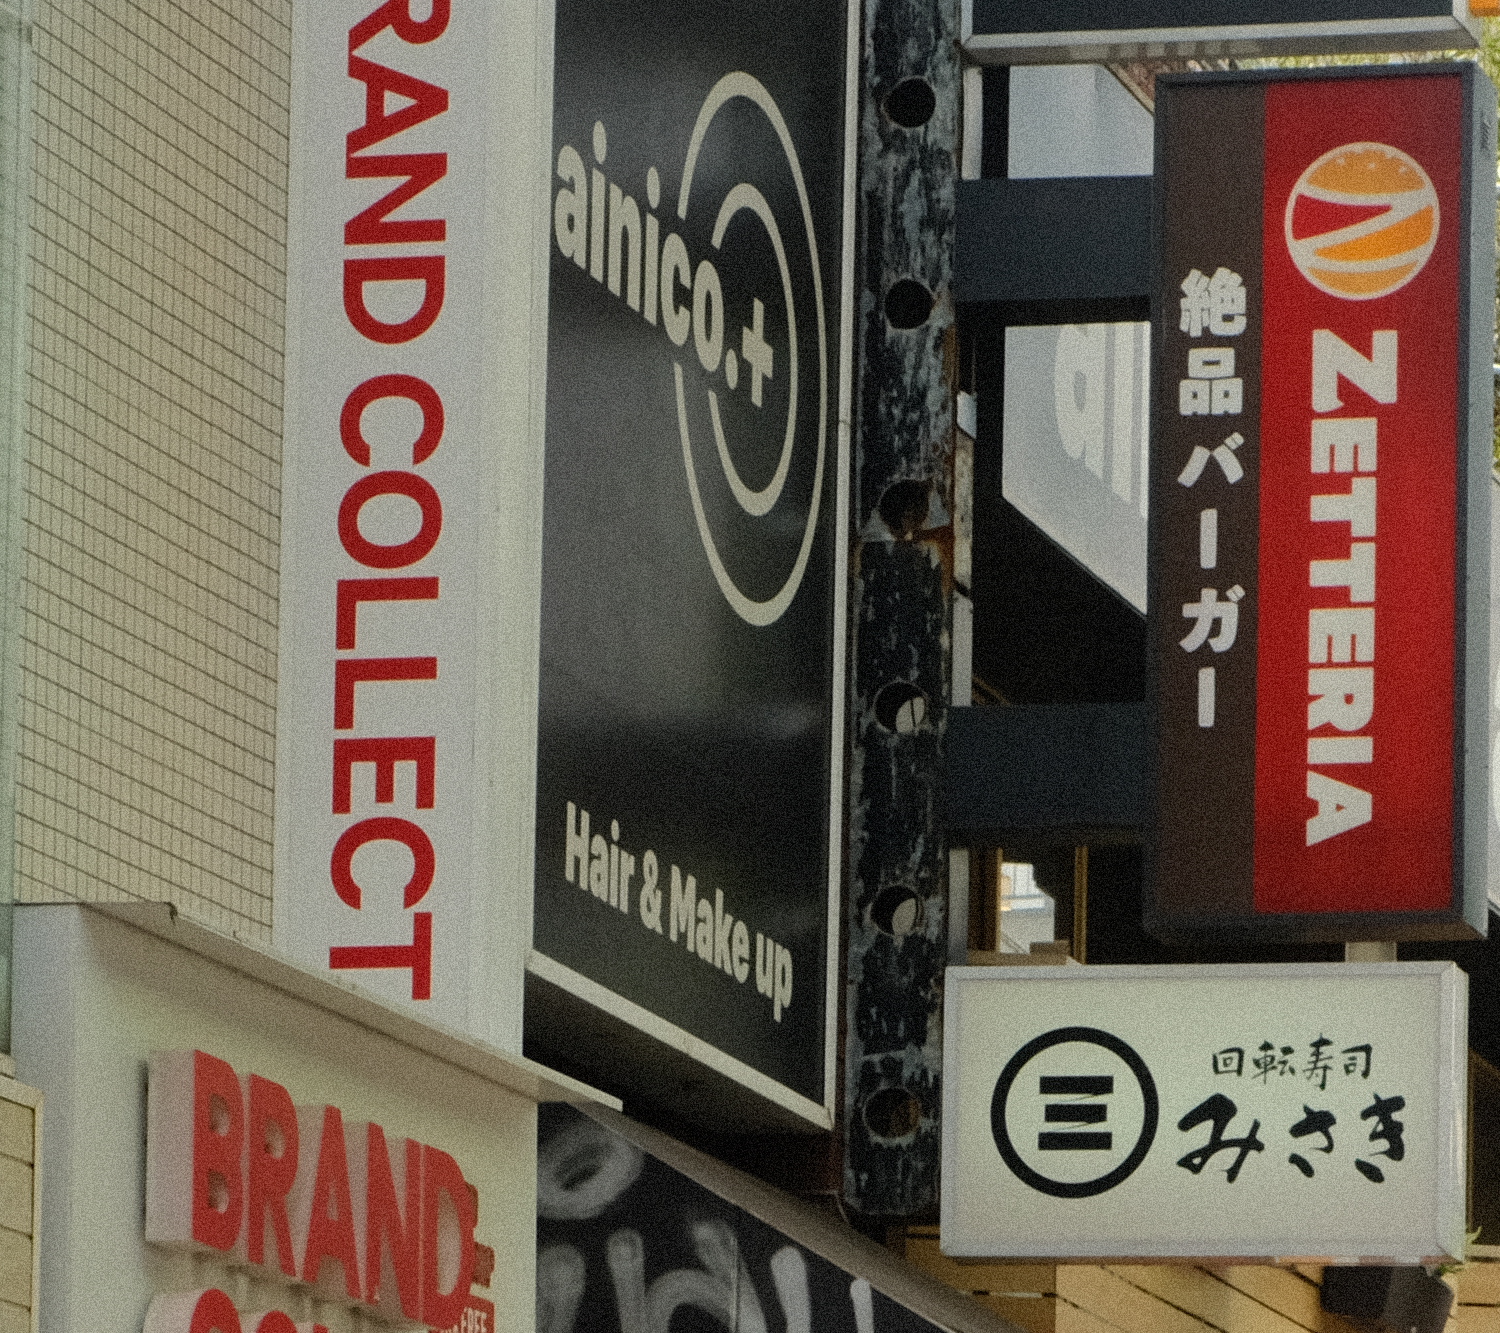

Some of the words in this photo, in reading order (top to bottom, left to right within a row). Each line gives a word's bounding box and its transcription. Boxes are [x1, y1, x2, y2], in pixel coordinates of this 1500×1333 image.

[1178, 267, 1247, 729] 絶品バーガー
[1305, 328, 1399, 848] ZETTERIA
[329, 373, 445, 1000] COLLECT
[564, 799, 636, 917] Hair
[639, 846, 665, 937] &
[668, 859, 750, 984] Make
[753, 937, 794, 1022] up
[191, 1048, 478, 1330] BRAND
[1177, 1092, 1408, 1184] みさき
[1211, 1034, 1375, 1092] 回転寿司
